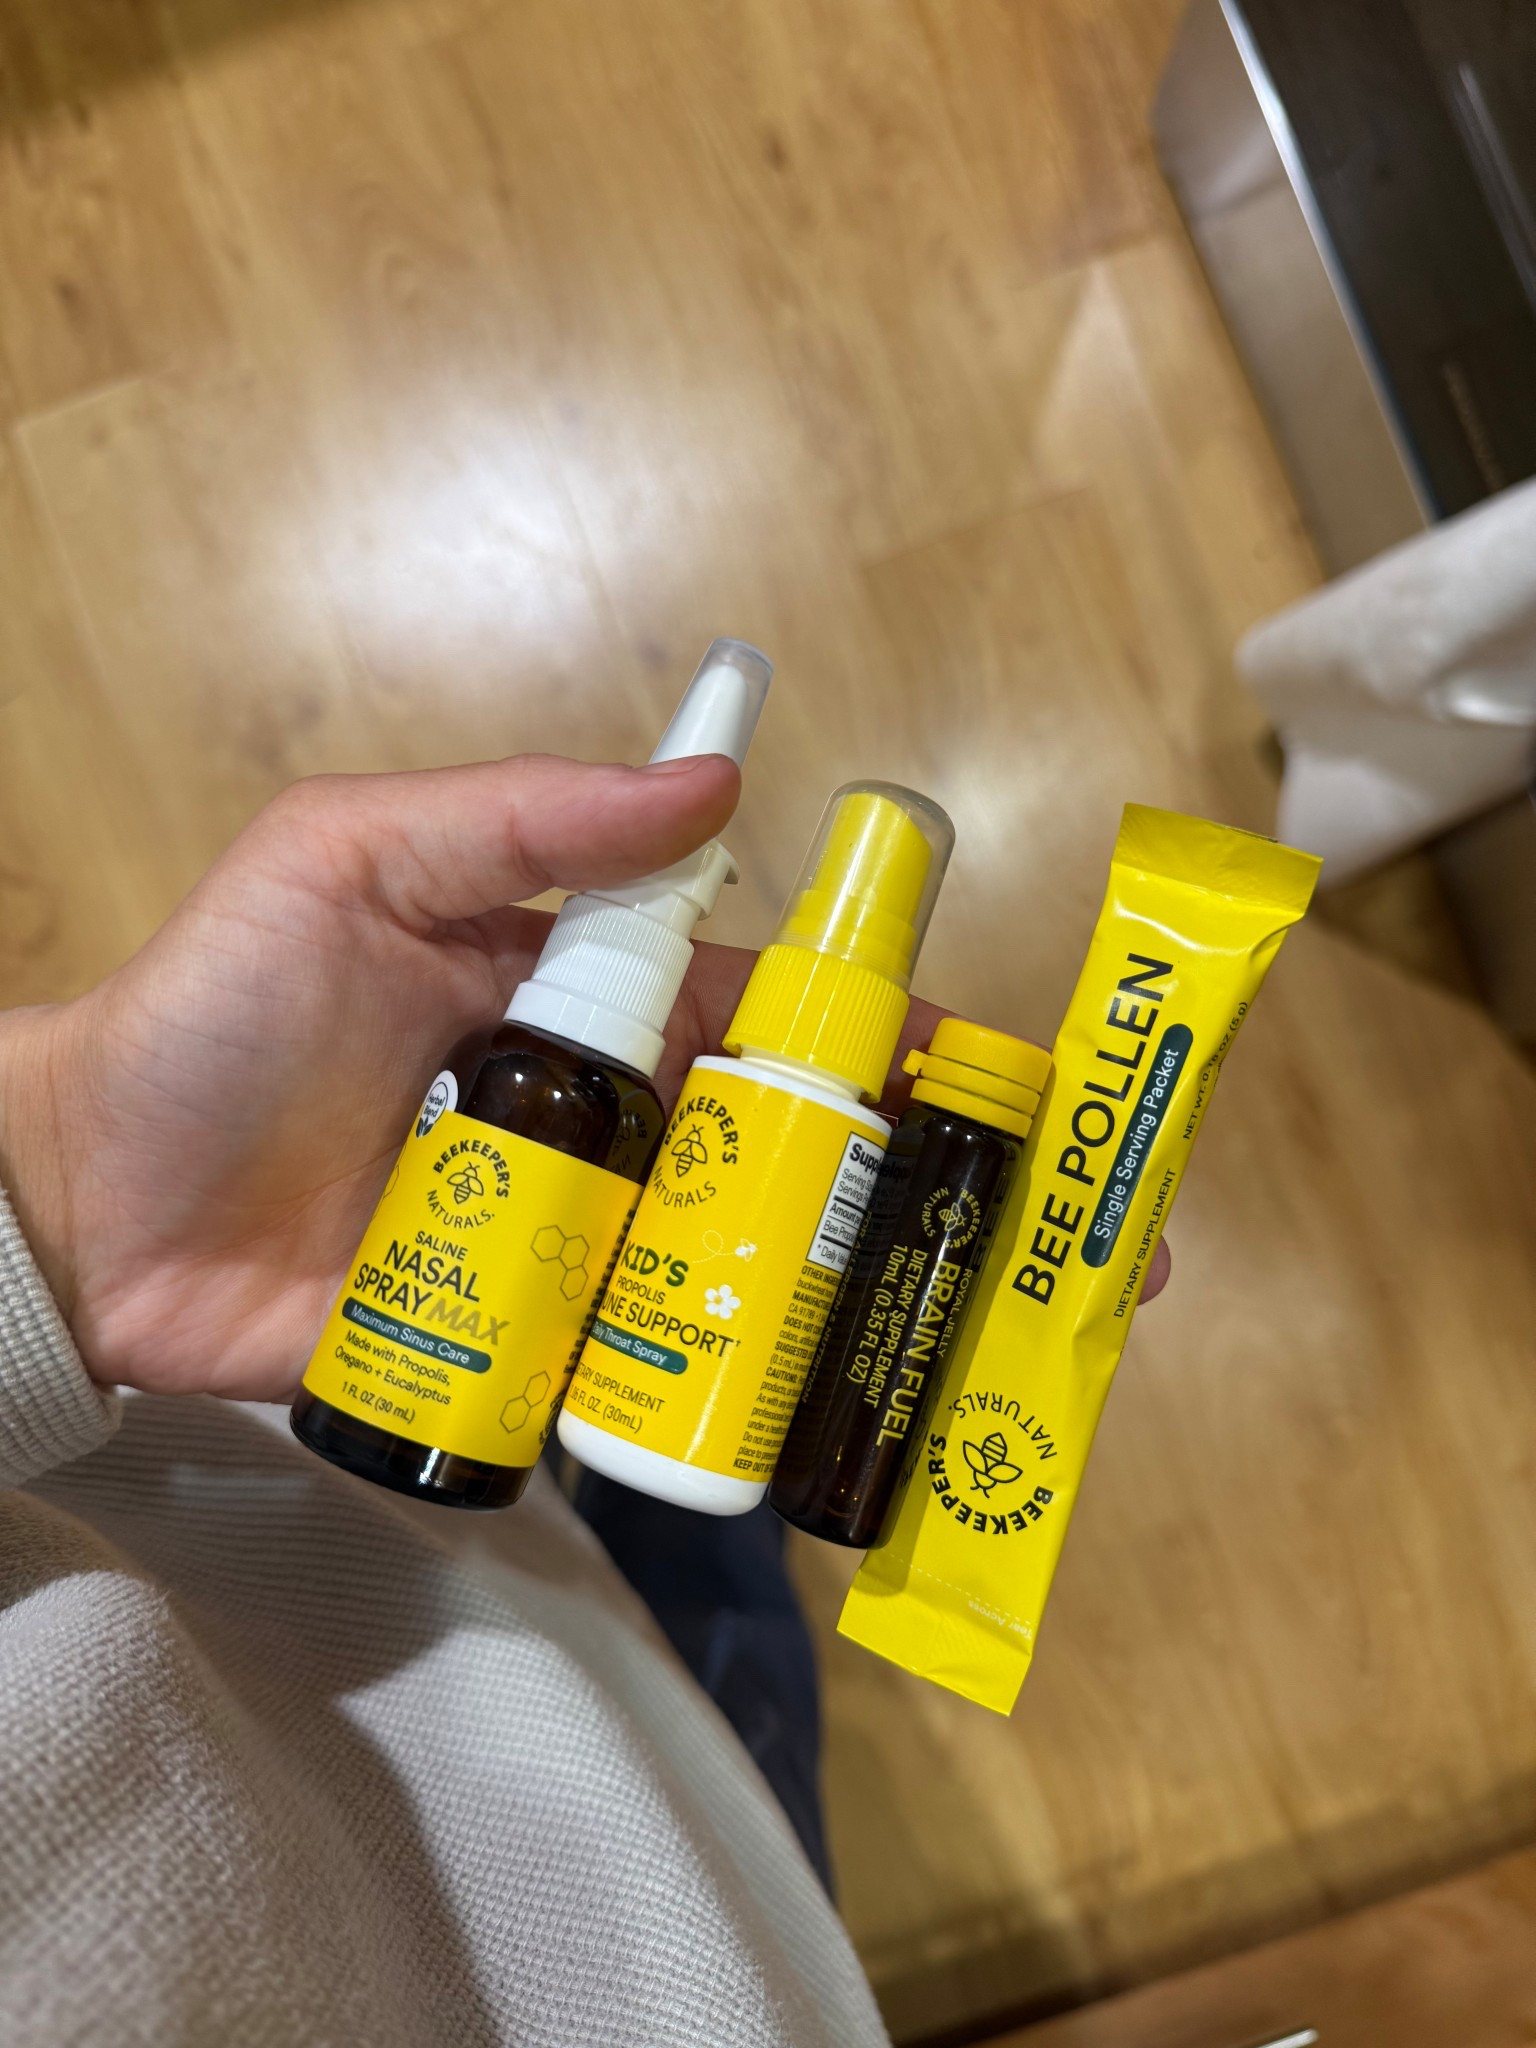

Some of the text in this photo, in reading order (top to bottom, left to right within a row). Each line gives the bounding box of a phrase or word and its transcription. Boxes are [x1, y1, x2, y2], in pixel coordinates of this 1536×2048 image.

[1183, 1111, 1198, 1139] NET
[1219, 1033, 1231, 1052] OZ
[664, 1096, 739, 1165] BEEKEEPER'S
[1011, 952, 1174, 1306] BEE POLLEN
[1093, 1048, 1180, 1240] Single Serving Packet
[433, 1139, 511, 1199] BEEKEEPER'S
[653, 1165, 716, 1208] NATURALS
[837, 1180, 864, 1202] Servings
[841, 1168, 866, 1190] Serving
[823, 1219, 838, 1235] Bee
[829, 1203, 857, 1221] Amount
[922, 1186, 949, 1237] NATURALS
[944, 1188, 981, 1249] BEEKEEPER'S
[415, 1230, 468, 1261] SALINE
[620, 1239, 690, 1287] KID'S
[821, 1246, 838, 1264] Daily
[1113, 1168, 1176, 1318] DIETARY SUPPLEMENT
[384, 1239, 480, 1303] NASAL
[616, 1275, 666, 1306] PROPOLIS
[801, 1265, 824, 1281] OTHER
[354, 1262, 433, 1316] SPRAY
[425, 1298, 511, 1346] MAX
[783, 1315, 802, 1330] DOES
[802, 1321, 815, 1334] NOT
[788, 1302, 798, 1314] CA
[799, 1306, 816, 1321] 91789
[846, 1244, 908, 1384] 10mL (0.35 FL OZ)
[937, 1268, 973, 1358] ROYAL JELLY
[350, 1303, 470, 1365] Maximum Sinus Care
[604, 1327, 633, 1351] Throat
[632, 1340, 668, 1366] Spray
[774, 1340, 808, 1359] SUGGESTED
[863, 1248, 928, 1409] DIETARY SUPPLEMENT
[334, 1345, 373, 1374] Oregano
[384, 1369, 451, 1405] Eucalyptus
[345, 1329, 451, 1386] Made with Propolis,
[876, 1260, 961, 1447] BRAIN FUEL
[341, 1381, 416, 1425] 1 FL OZ (30 mL)
[579, 1388, 589, 1406] FL
[602, 1402, 643, 1434] (30mL)
[593, 1372, 665, 1413] SUPPLEMENT
[756, 1393, 767, 1403] As
[767, 1396, 779, 1407] with
[742, 1431, 753, 1443] Do
[752, 1436, 763, 1446] not
[747, 1420, 766, 1432] under
[733, 1457, 753, 1471] KEEP
[752, 1462, 766, 1473] OUT
[736, 1445, 756, 1458] place
[928, 1433, 1054, 1535] BEEKEEPER'S
